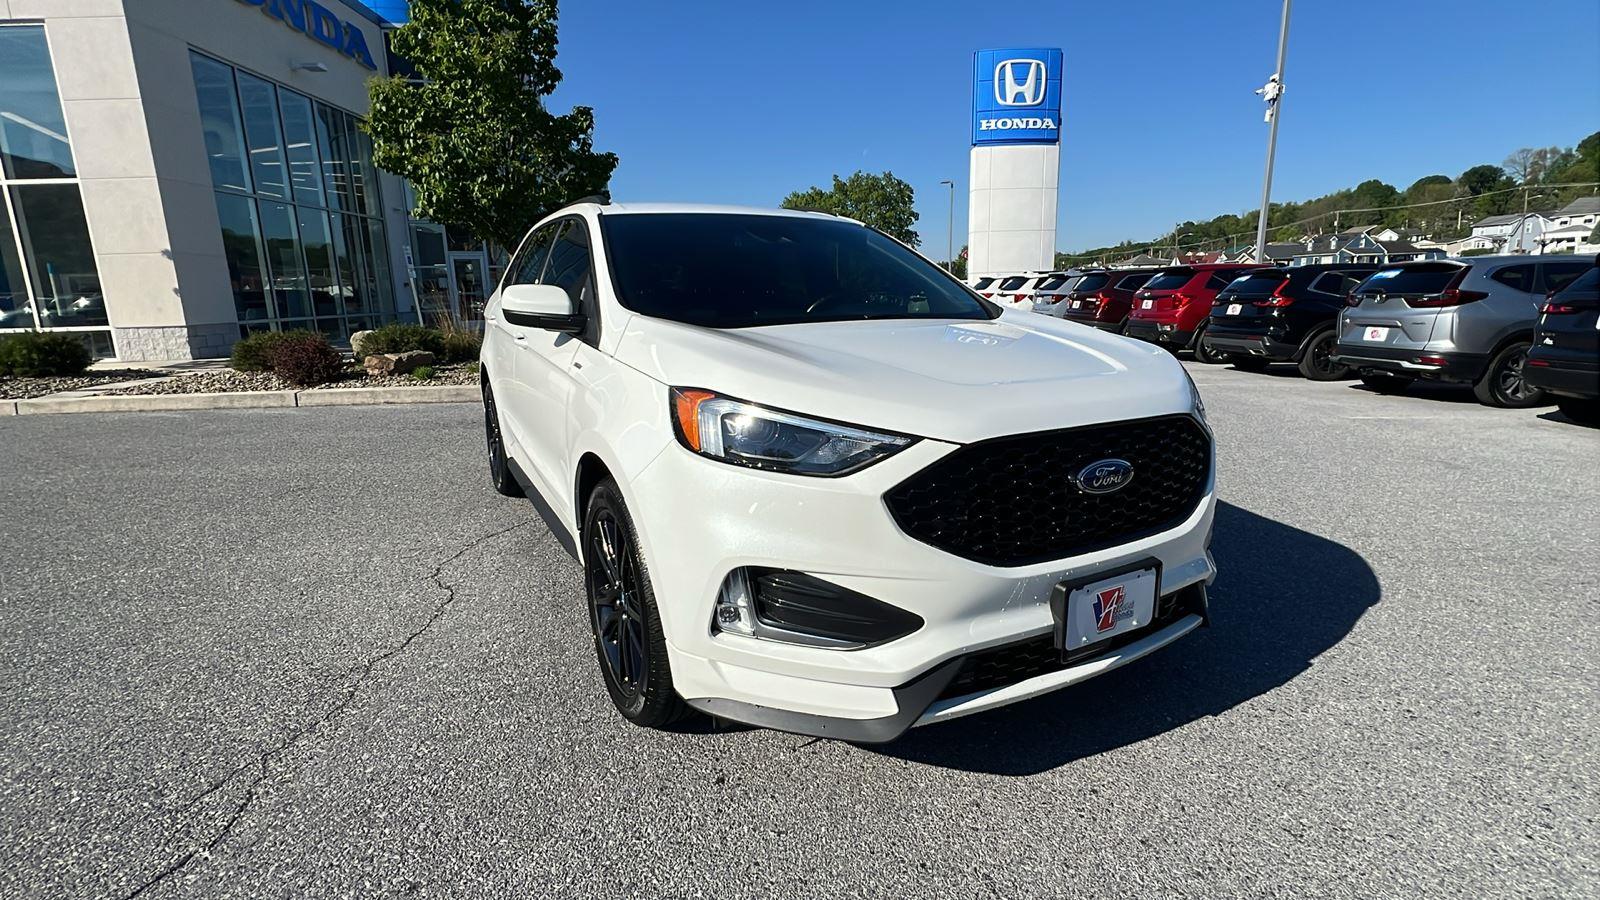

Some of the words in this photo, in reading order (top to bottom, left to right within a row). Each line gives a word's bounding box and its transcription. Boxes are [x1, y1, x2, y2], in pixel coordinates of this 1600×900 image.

[236, 0, 377, 70] NDA
[980, 118, 1057, 130] HONDA
[1093, 467, 1124, 487] Ford
